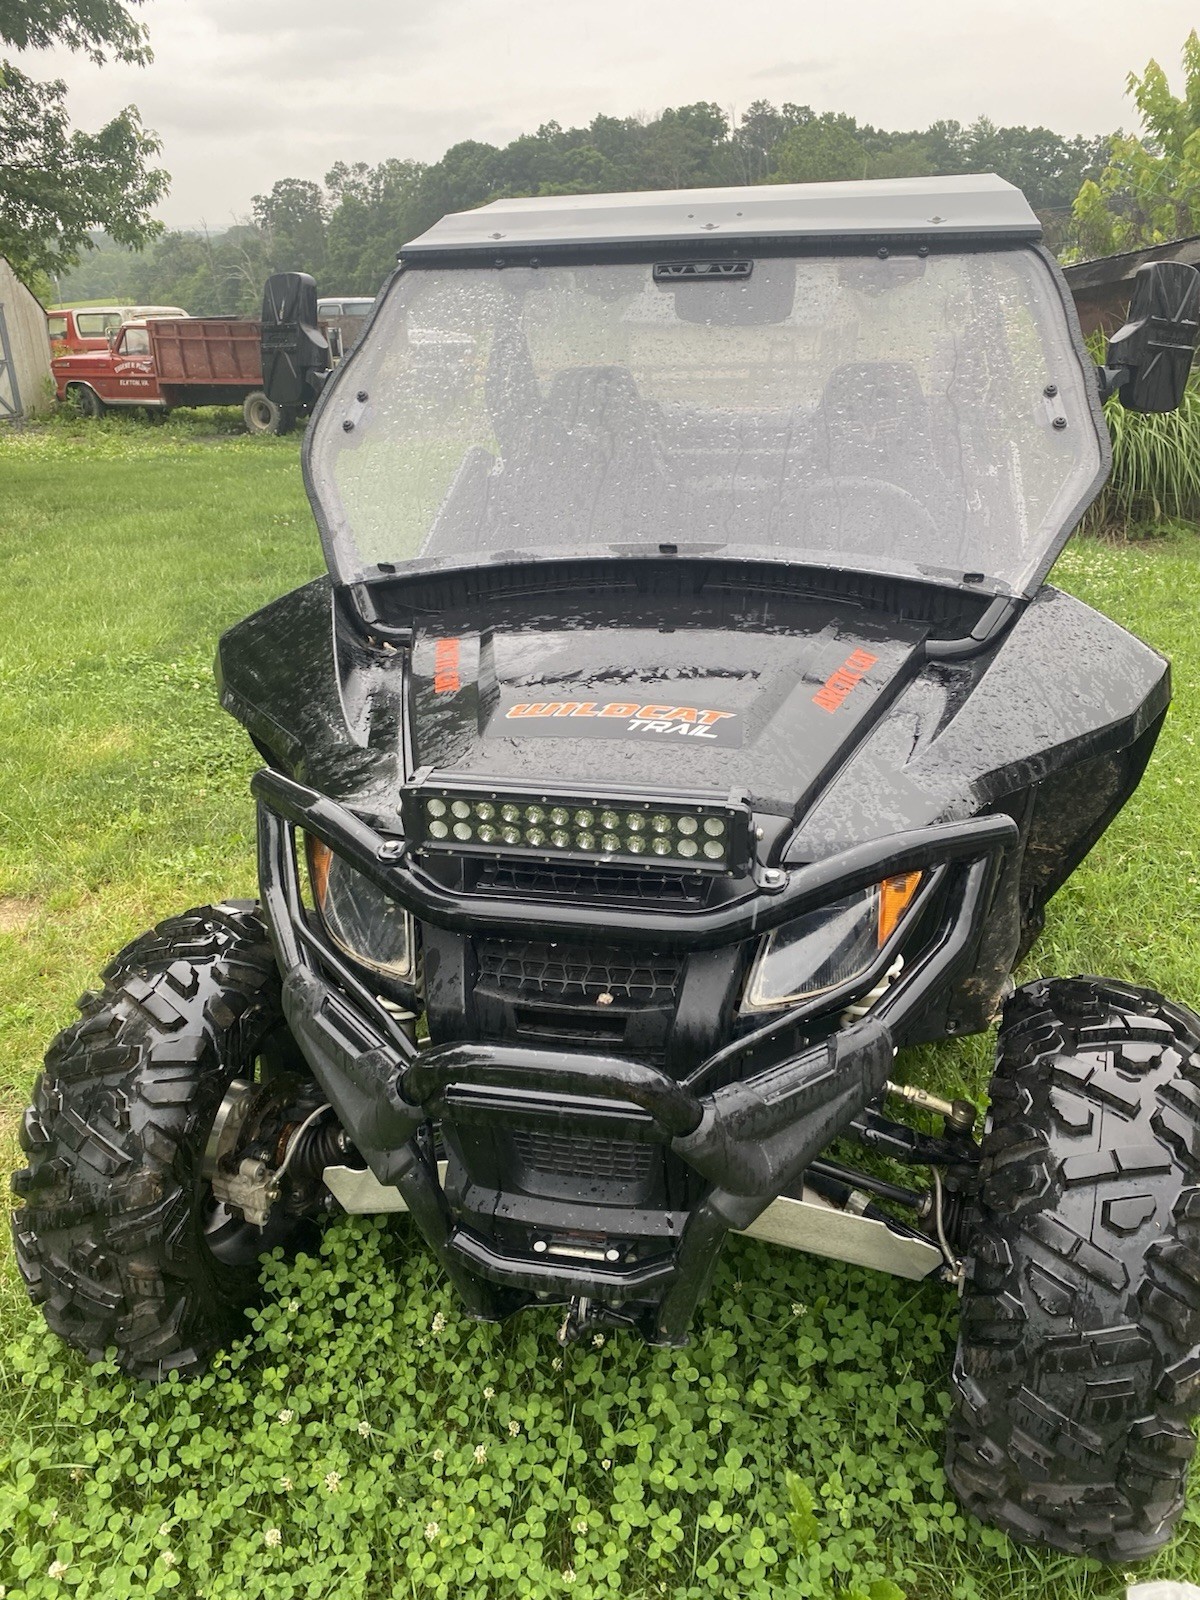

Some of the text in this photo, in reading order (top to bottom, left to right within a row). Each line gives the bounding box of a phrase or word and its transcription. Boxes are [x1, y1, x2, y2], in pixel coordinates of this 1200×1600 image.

[811, 646, 879, 715] ARCTIC CAT
[505, 701, 738, 726] WILDCAT
[626, 718, 718, 739] TRAIL
